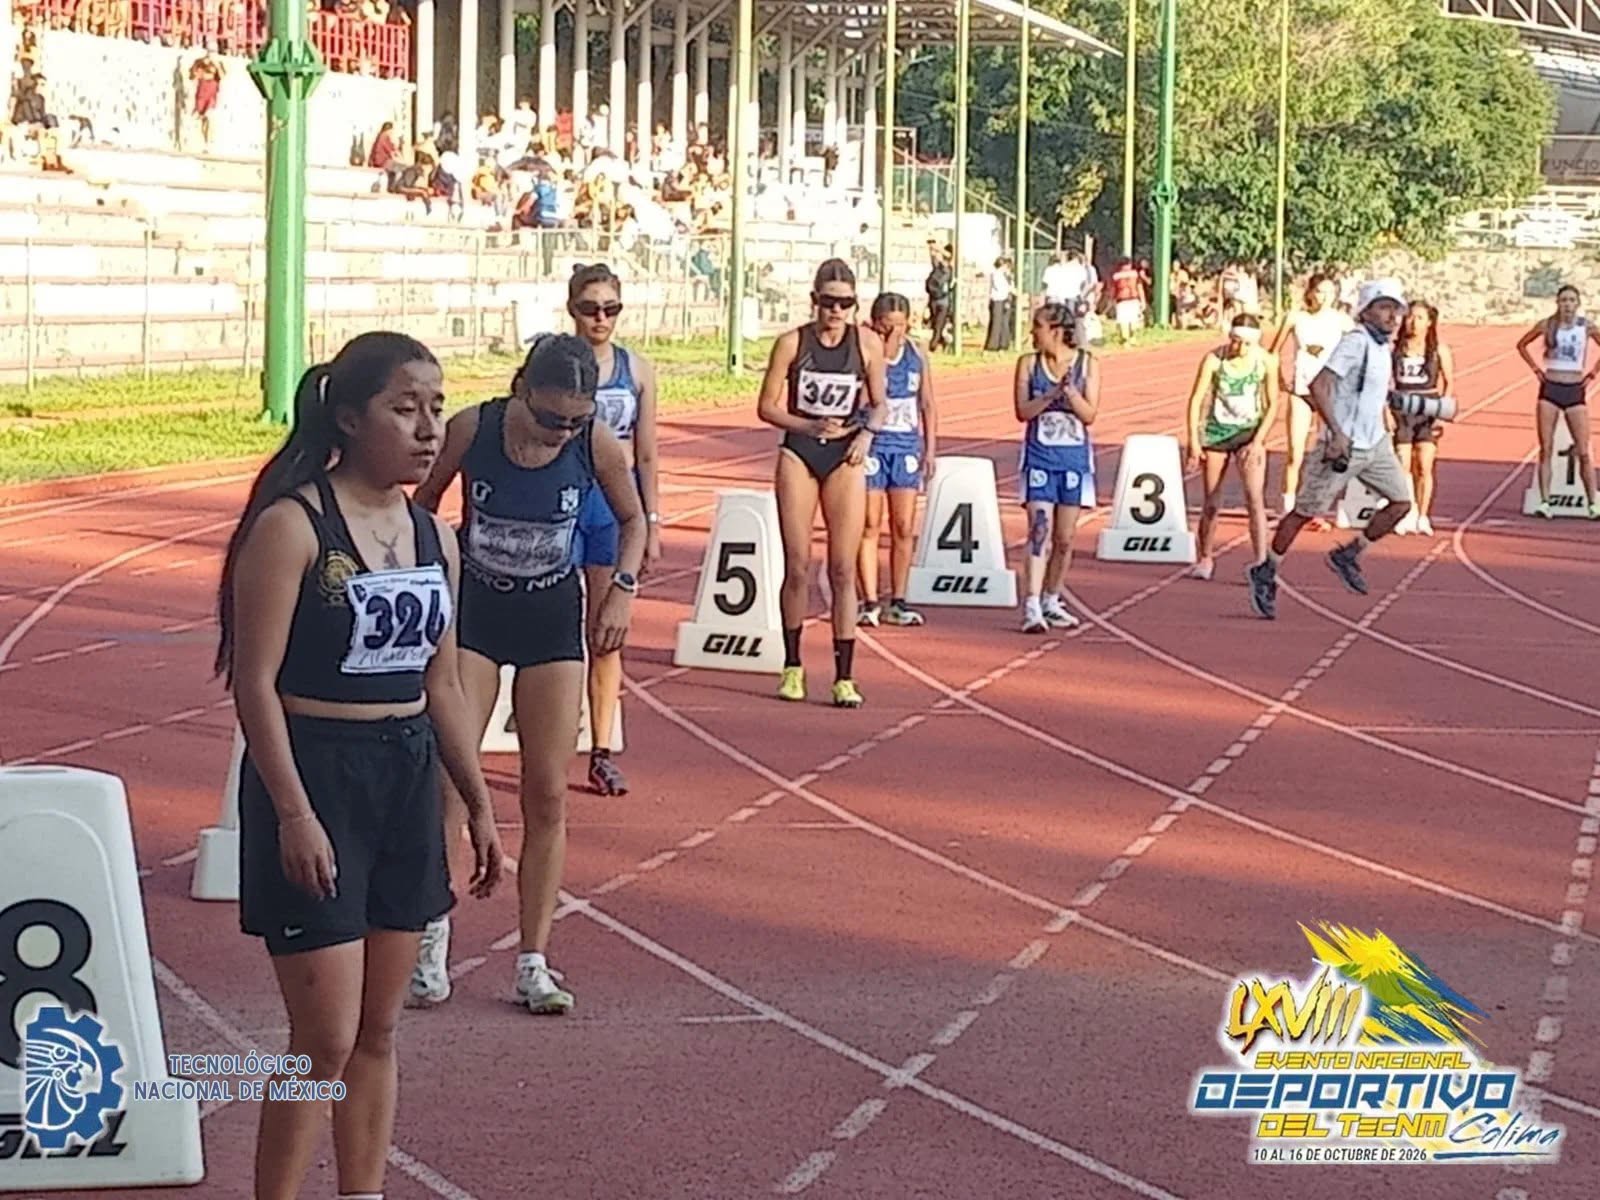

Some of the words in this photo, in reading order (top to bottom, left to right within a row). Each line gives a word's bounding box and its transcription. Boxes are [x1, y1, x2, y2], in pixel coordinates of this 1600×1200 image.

[803, 380, 851, 407] 367
[1130, 472, 1165, 525] 3
[937, 503, 979, 563] 4
[1123, 536, 1172, 552] GILL
[713, 542, 757, 616] 5
[932, 575, 989, 594] GILL
[702, 633, 762, 658] GILL
[0, 899, 97, 1070] 8
